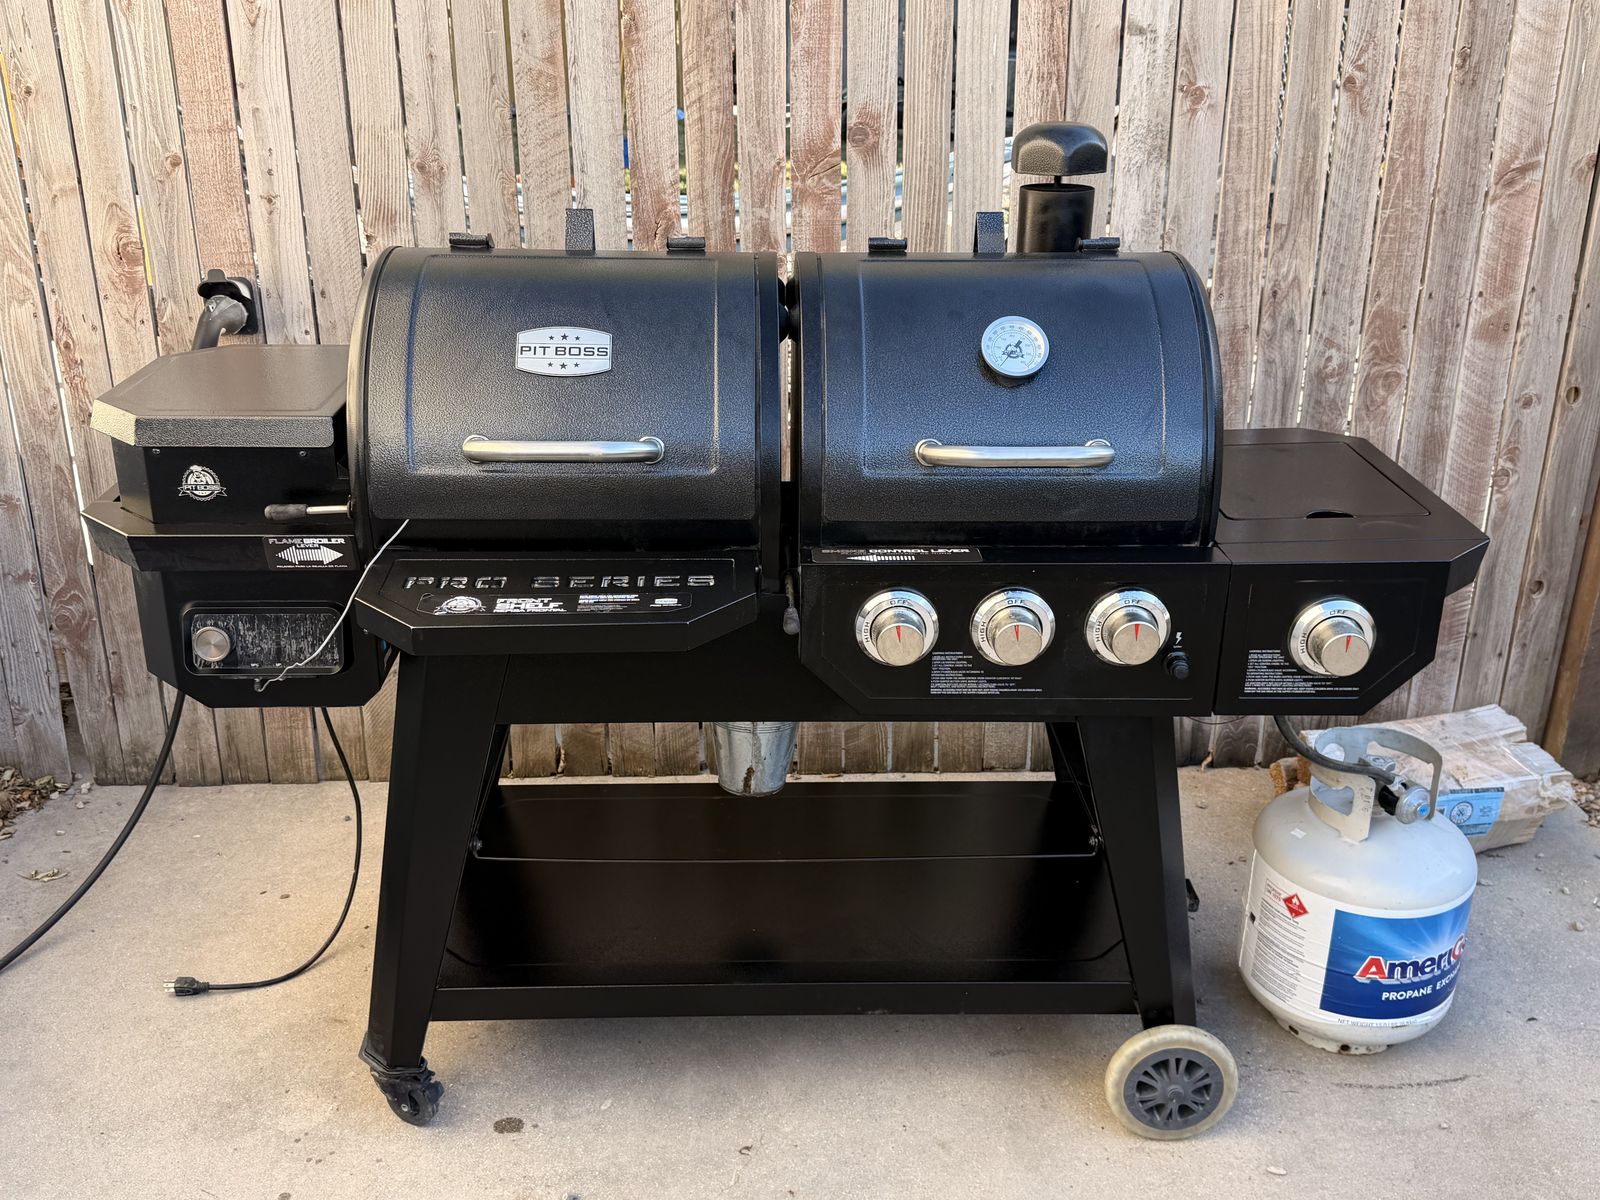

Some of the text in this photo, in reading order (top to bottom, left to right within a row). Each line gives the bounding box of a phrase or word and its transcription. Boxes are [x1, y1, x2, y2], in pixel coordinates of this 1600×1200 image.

[520, 346, 609, 356] PIT BOSS
[403, 575, 716, 588] PRO SERIES
[863, 621, 871, 643] HIGH
[979, 621, 987, 643] HIGH
[1095, 620, 1103, 643] HIGH
[1299, 632, 1308, 654] HIGH
[1381, 985, 1433, 1001] PROPANE
